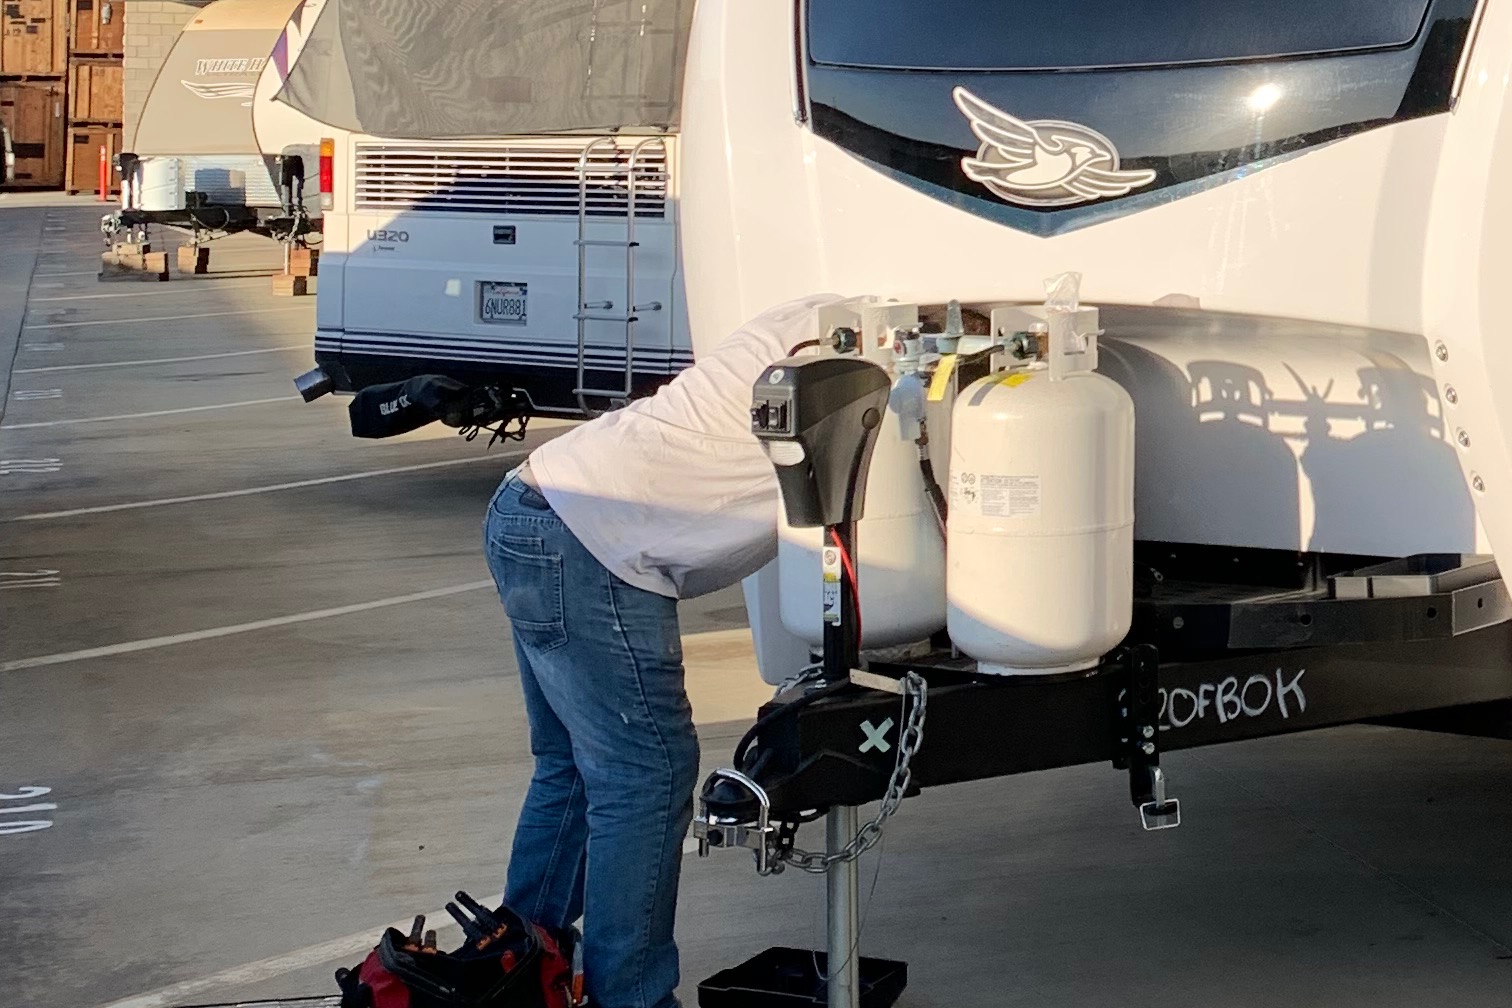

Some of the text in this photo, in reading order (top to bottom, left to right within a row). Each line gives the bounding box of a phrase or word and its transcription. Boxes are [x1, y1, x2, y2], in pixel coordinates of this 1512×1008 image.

[195, 58, 248, 75] WHITE
[367, 229, 410, 243] U320
[485, 298, 527, 317] 6NUR881
